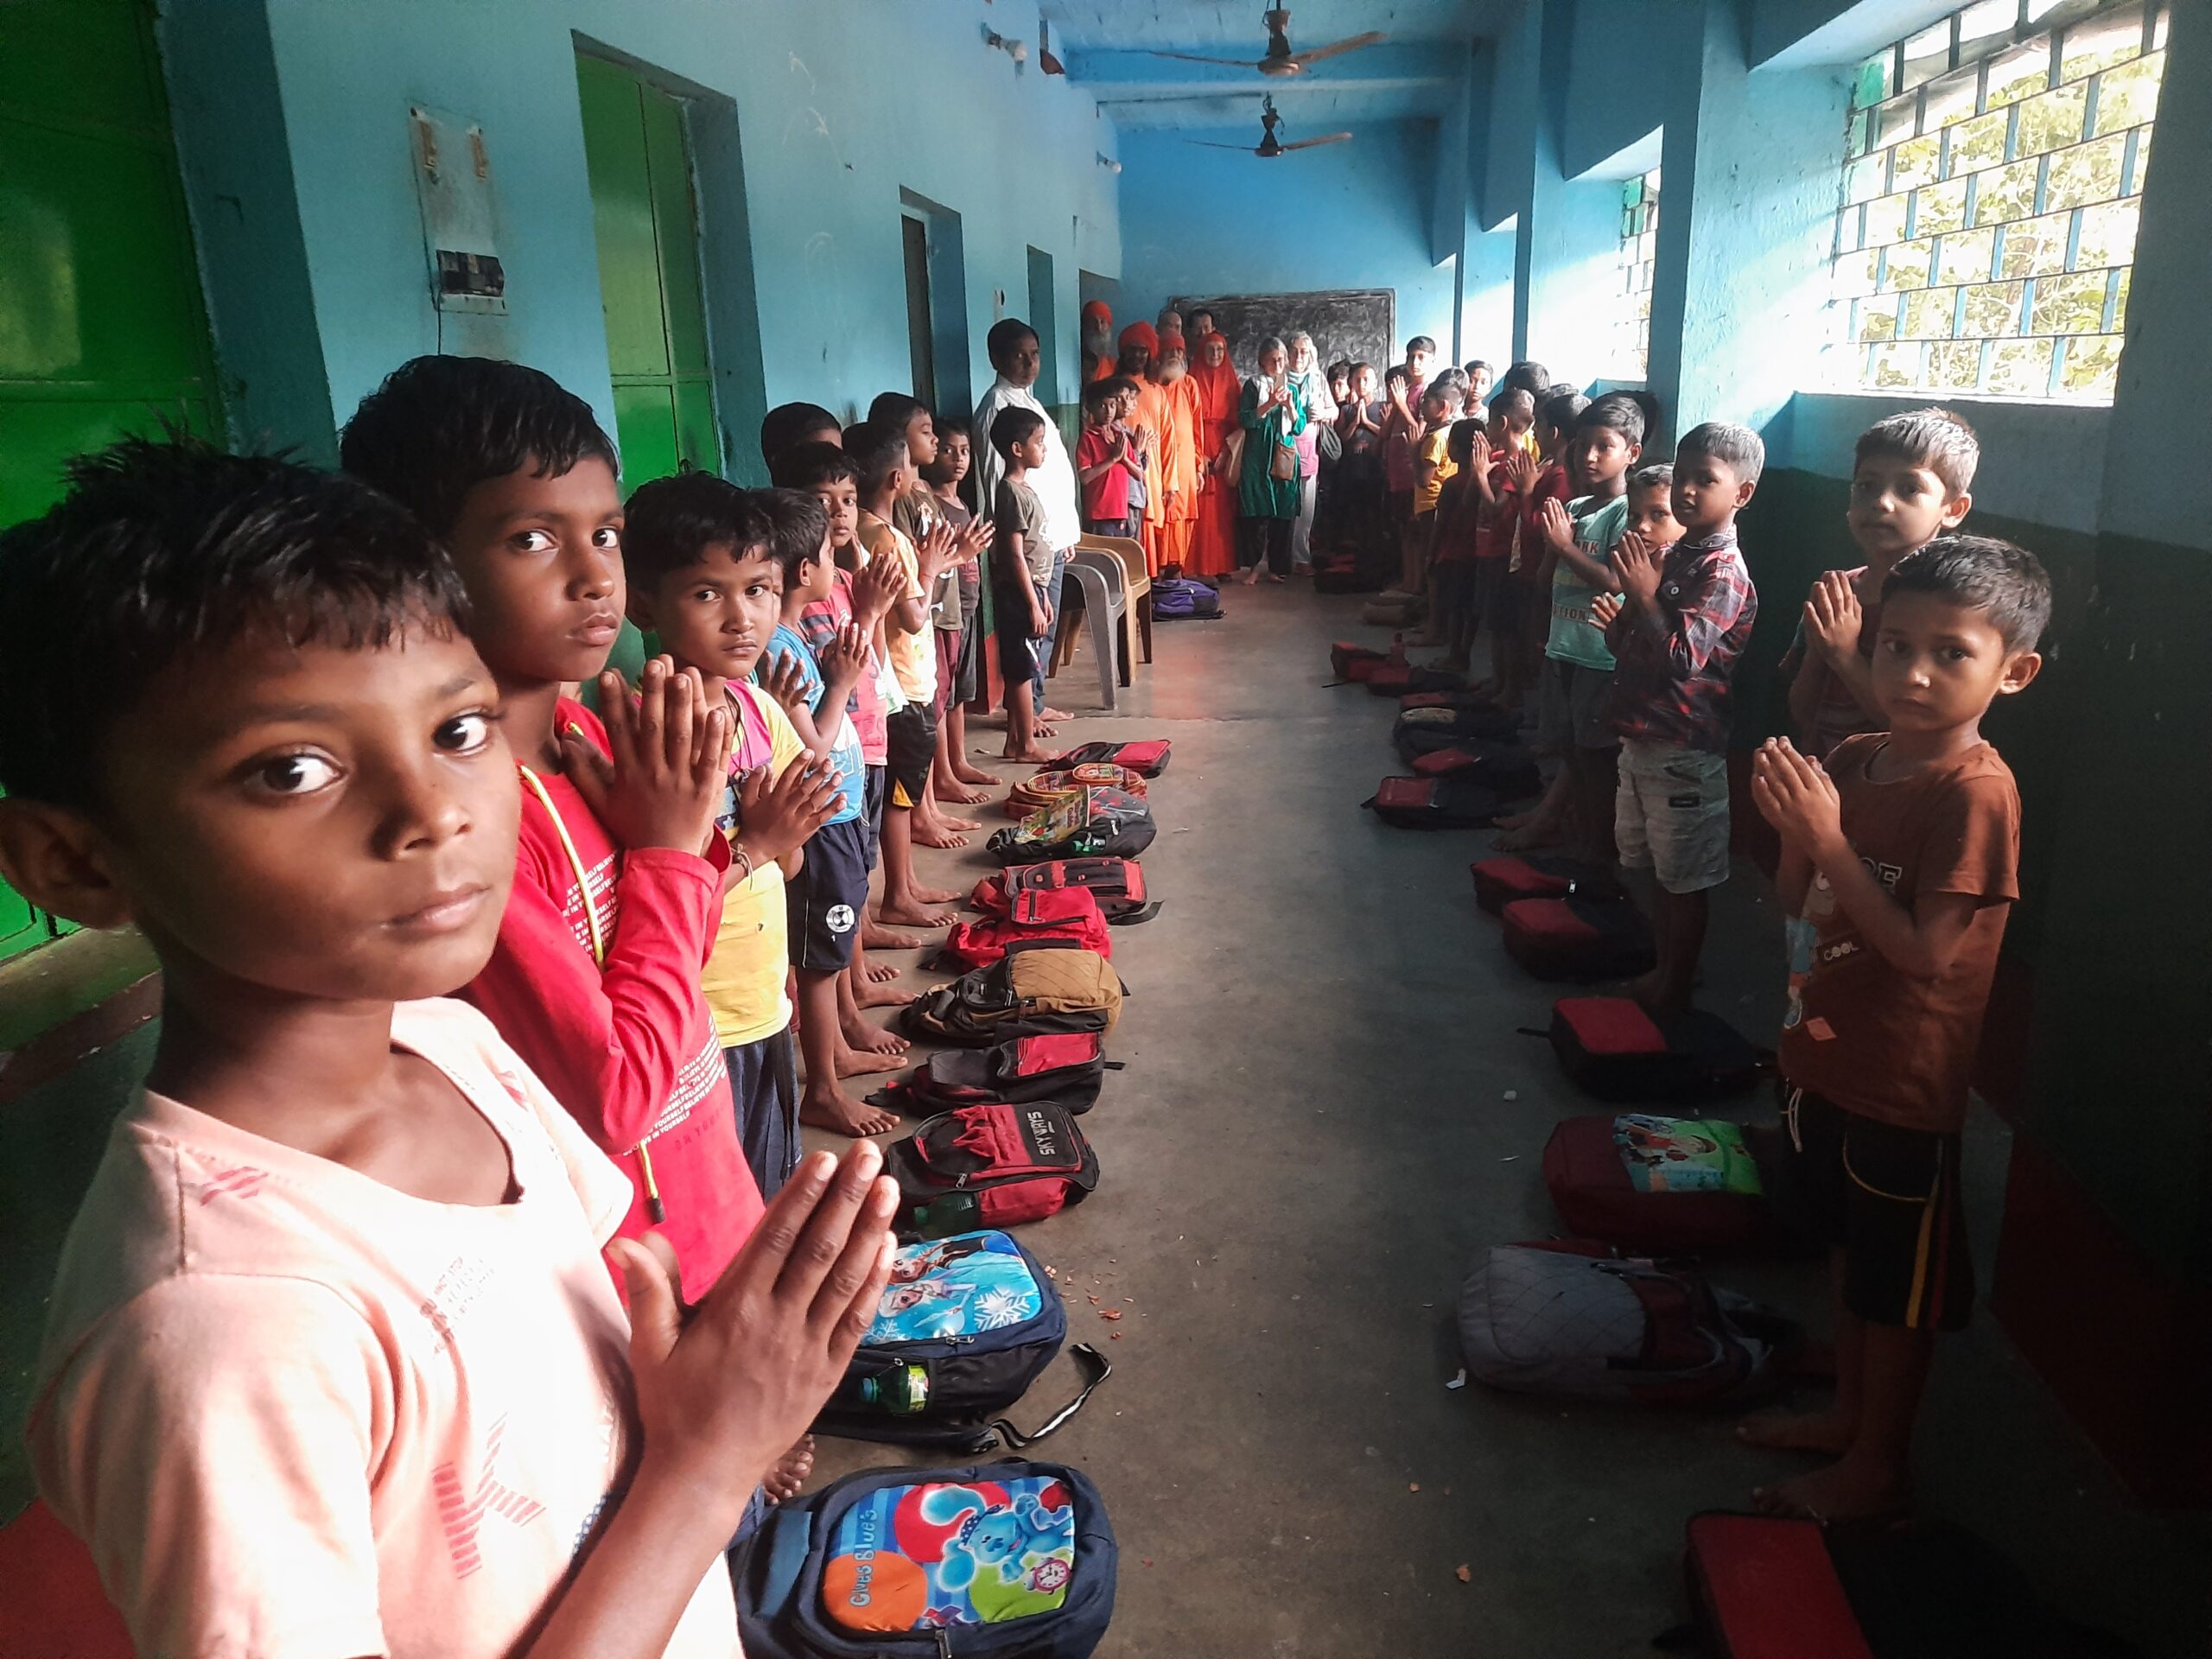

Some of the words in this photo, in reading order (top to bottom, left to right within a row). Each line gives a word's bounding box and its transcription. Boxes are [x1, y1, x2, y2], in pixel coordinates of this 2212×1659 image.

[1823, 941, 1859, 961] COOL
[659, 1110, 690, 1133] YOURSELF
[1027, 1111, 1056, 1156] SKYWAYS
[853, 1510, 878, 1561] Blue's
